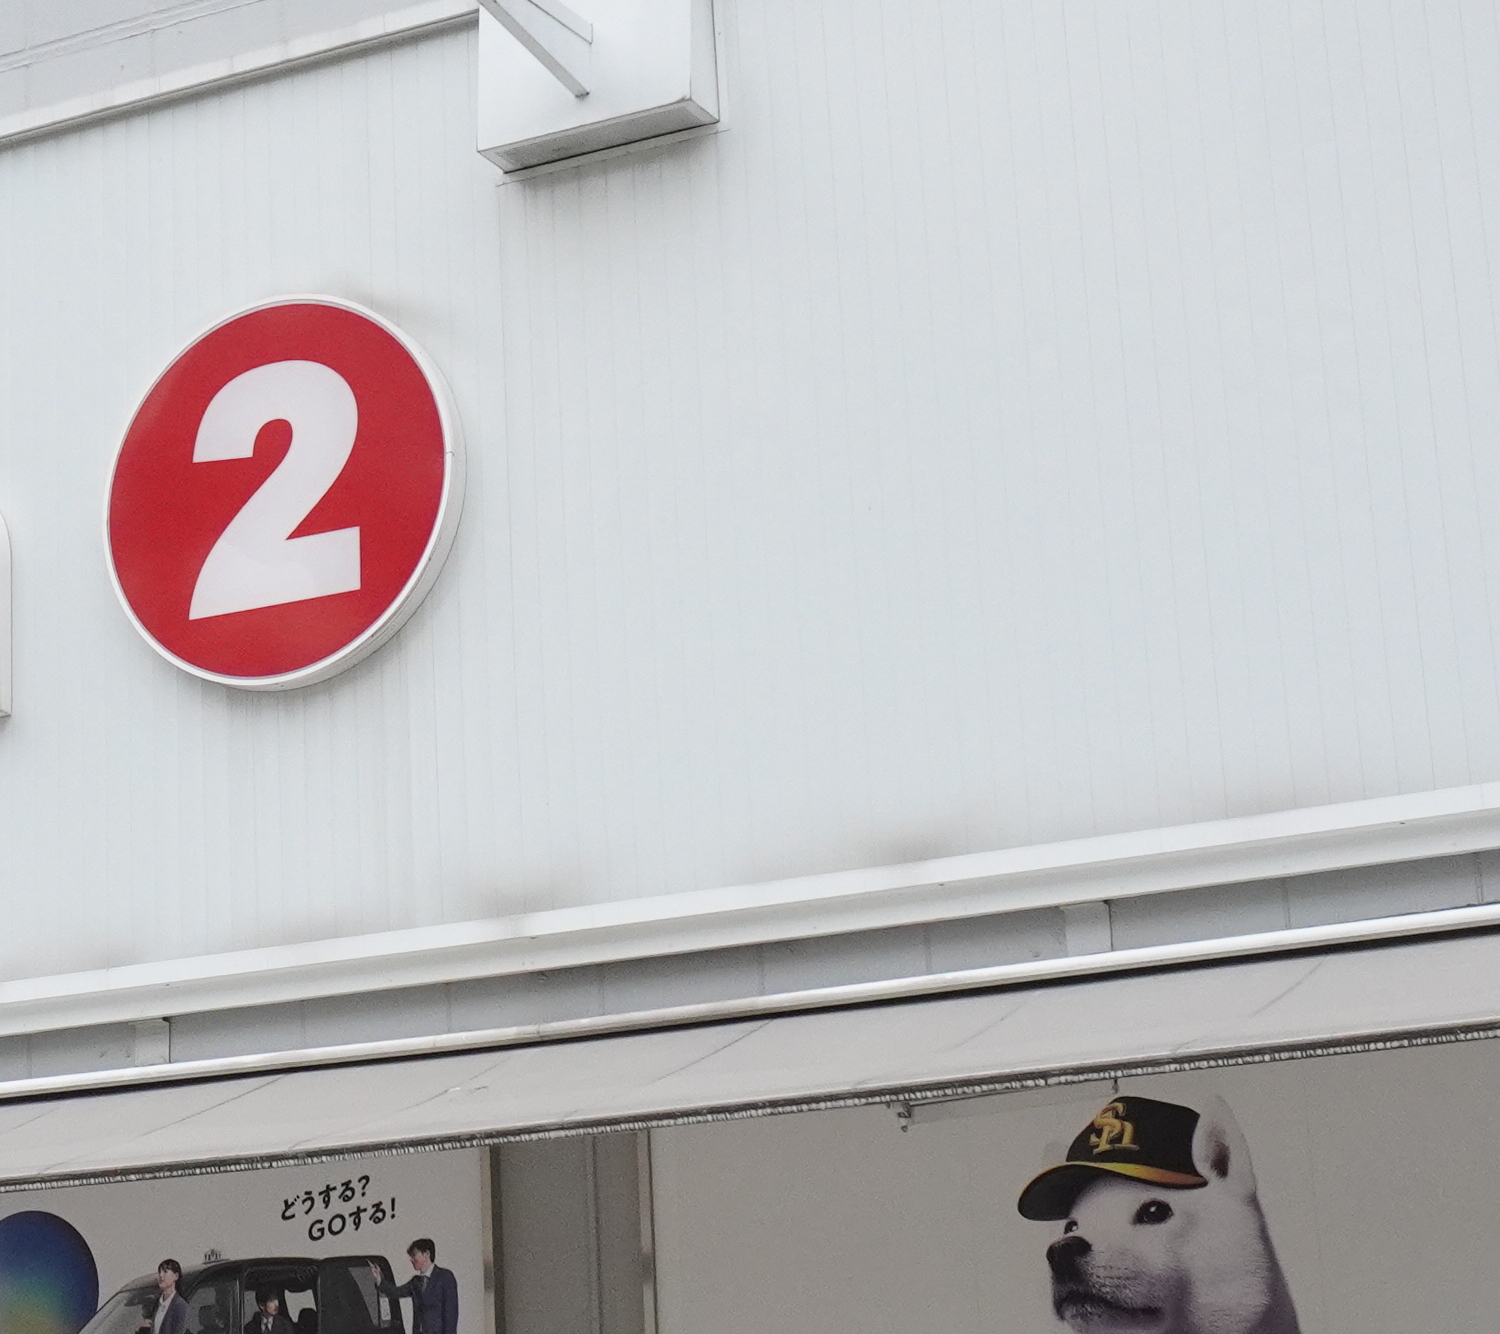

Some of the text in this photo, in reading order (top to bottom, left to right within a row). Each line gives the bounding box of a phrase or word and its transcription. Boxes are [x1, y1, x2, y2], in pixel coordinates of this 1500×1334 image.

[280, 1175, 371, 1223] どうする?
[308, 1198, 396, 1241] GOする!
